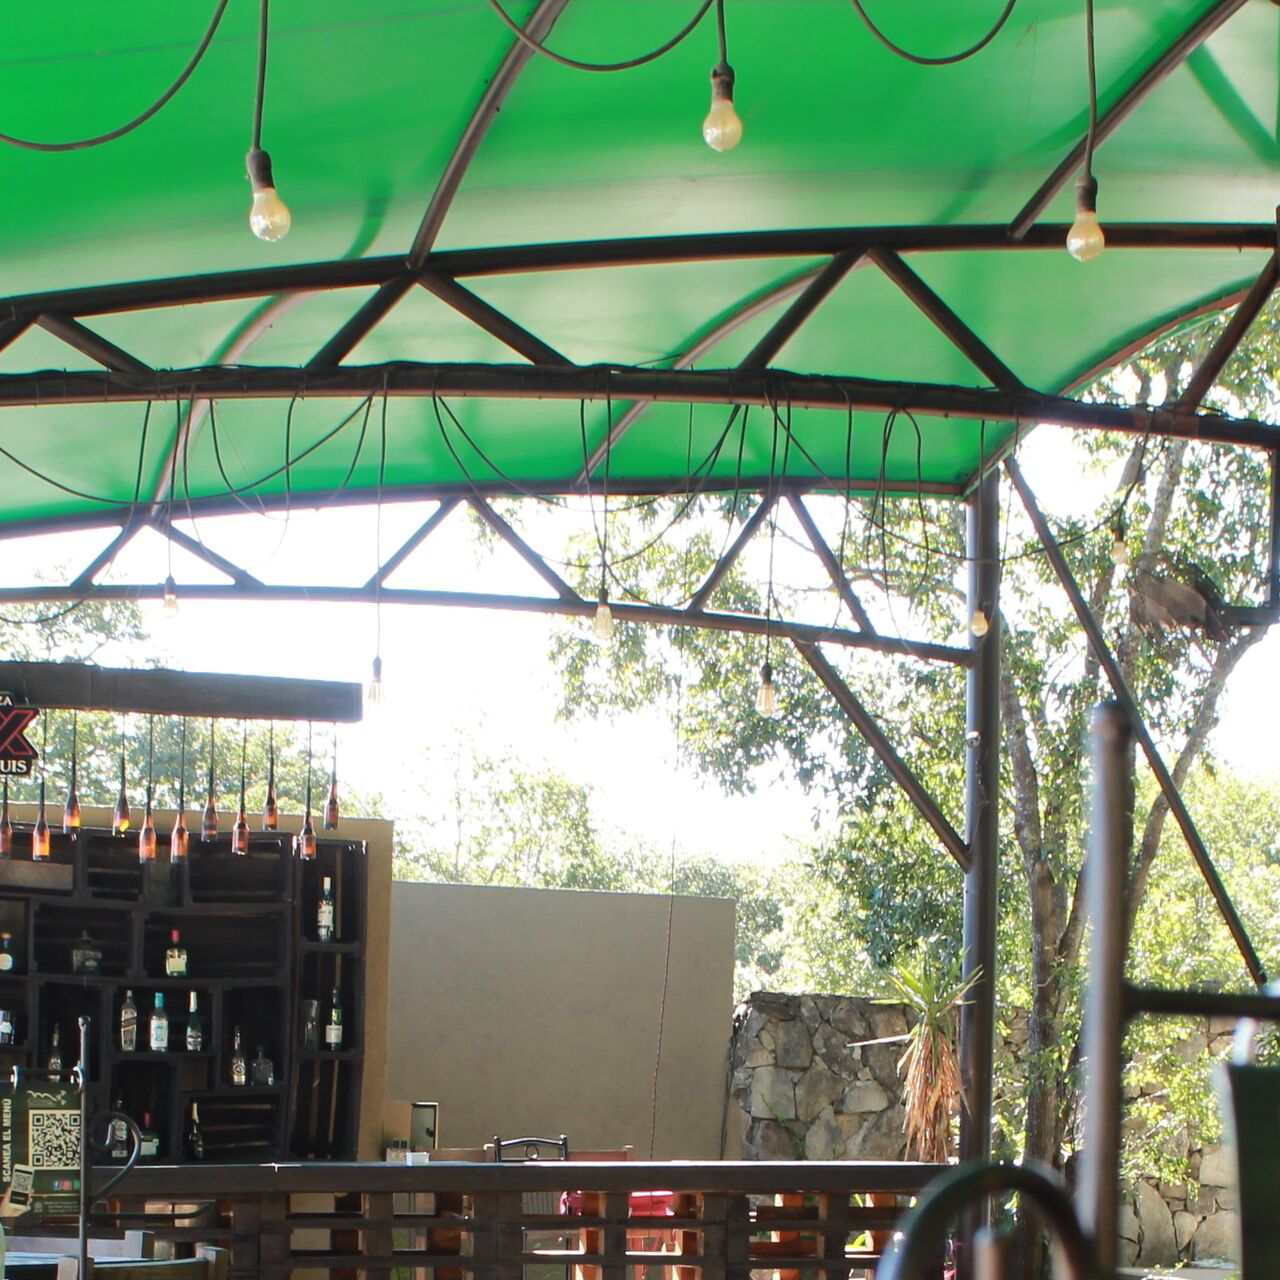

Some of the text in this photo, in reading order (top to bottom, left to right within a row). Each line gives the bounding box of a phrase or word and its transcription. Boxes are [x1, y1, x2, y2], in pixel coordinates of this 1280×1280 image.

[1, 1098, 12, 1183] SCANEA EL MENÚ
